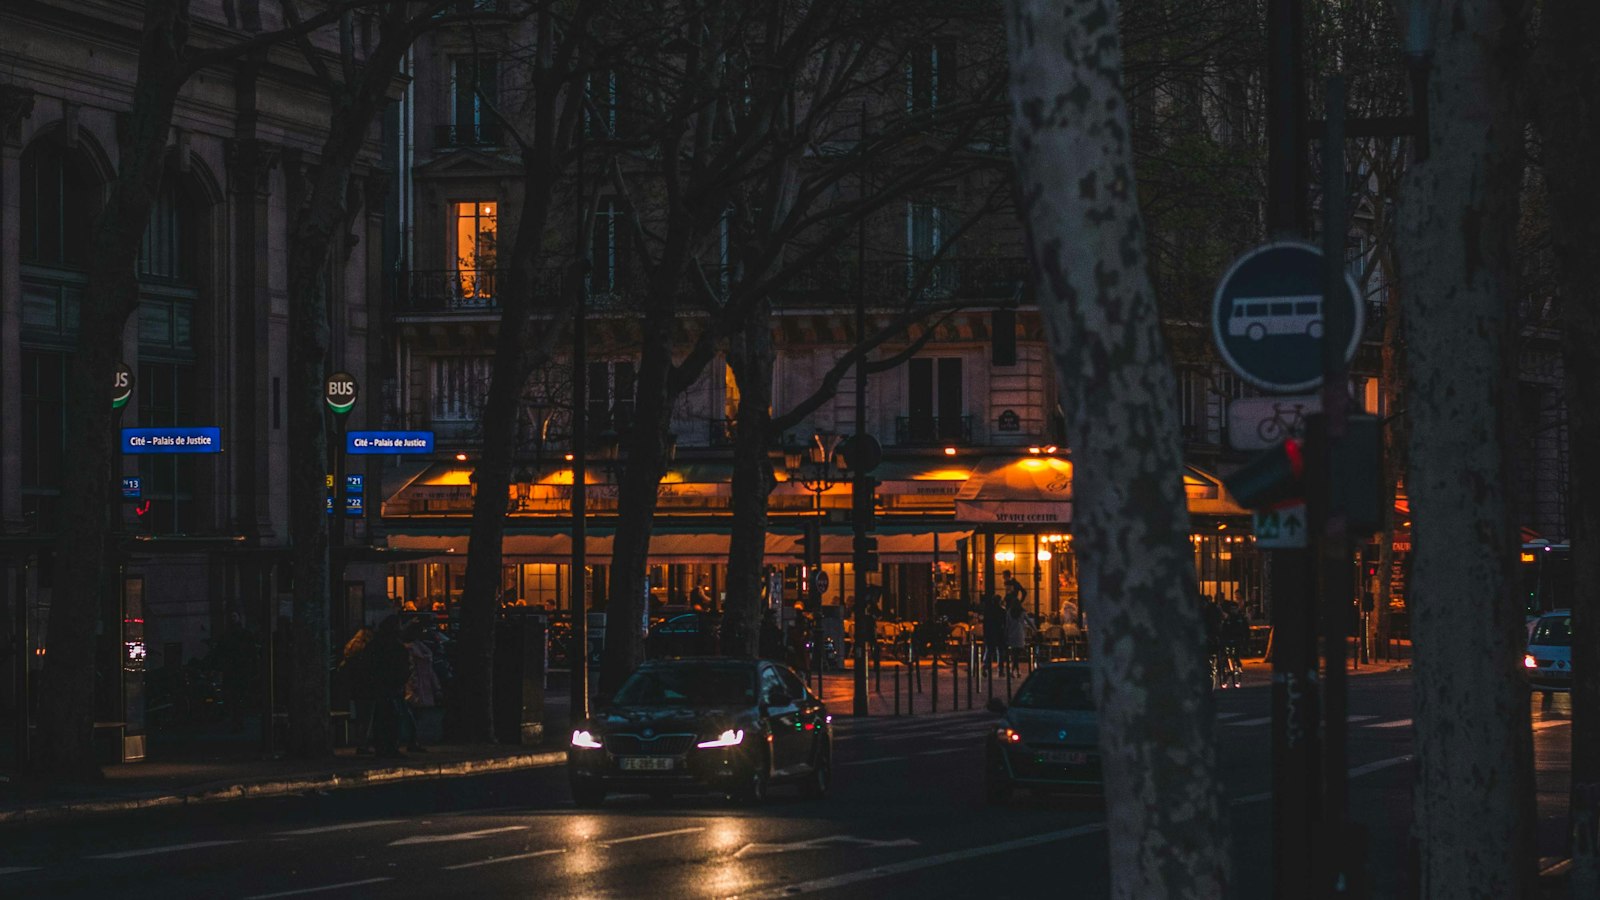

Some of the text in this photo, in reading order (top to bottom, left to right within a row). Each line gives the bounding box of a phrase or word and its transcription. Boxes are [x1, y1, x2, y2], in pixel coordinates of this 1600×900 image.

[114, 372, 128, 387] US
[328, 381, 354, 396] BUS
[130, 436, 145, 446] Cité
[153, 437, 175, 446] Palais
[175, 436, 185, 445] de
[186, 435, 211, 445] Justice
[354, 438, 368, 447] Cité
[374, 438, 393, 447] Palais
[394, 438, 402, 447] de
[404, 438, 427, 447] Justice
